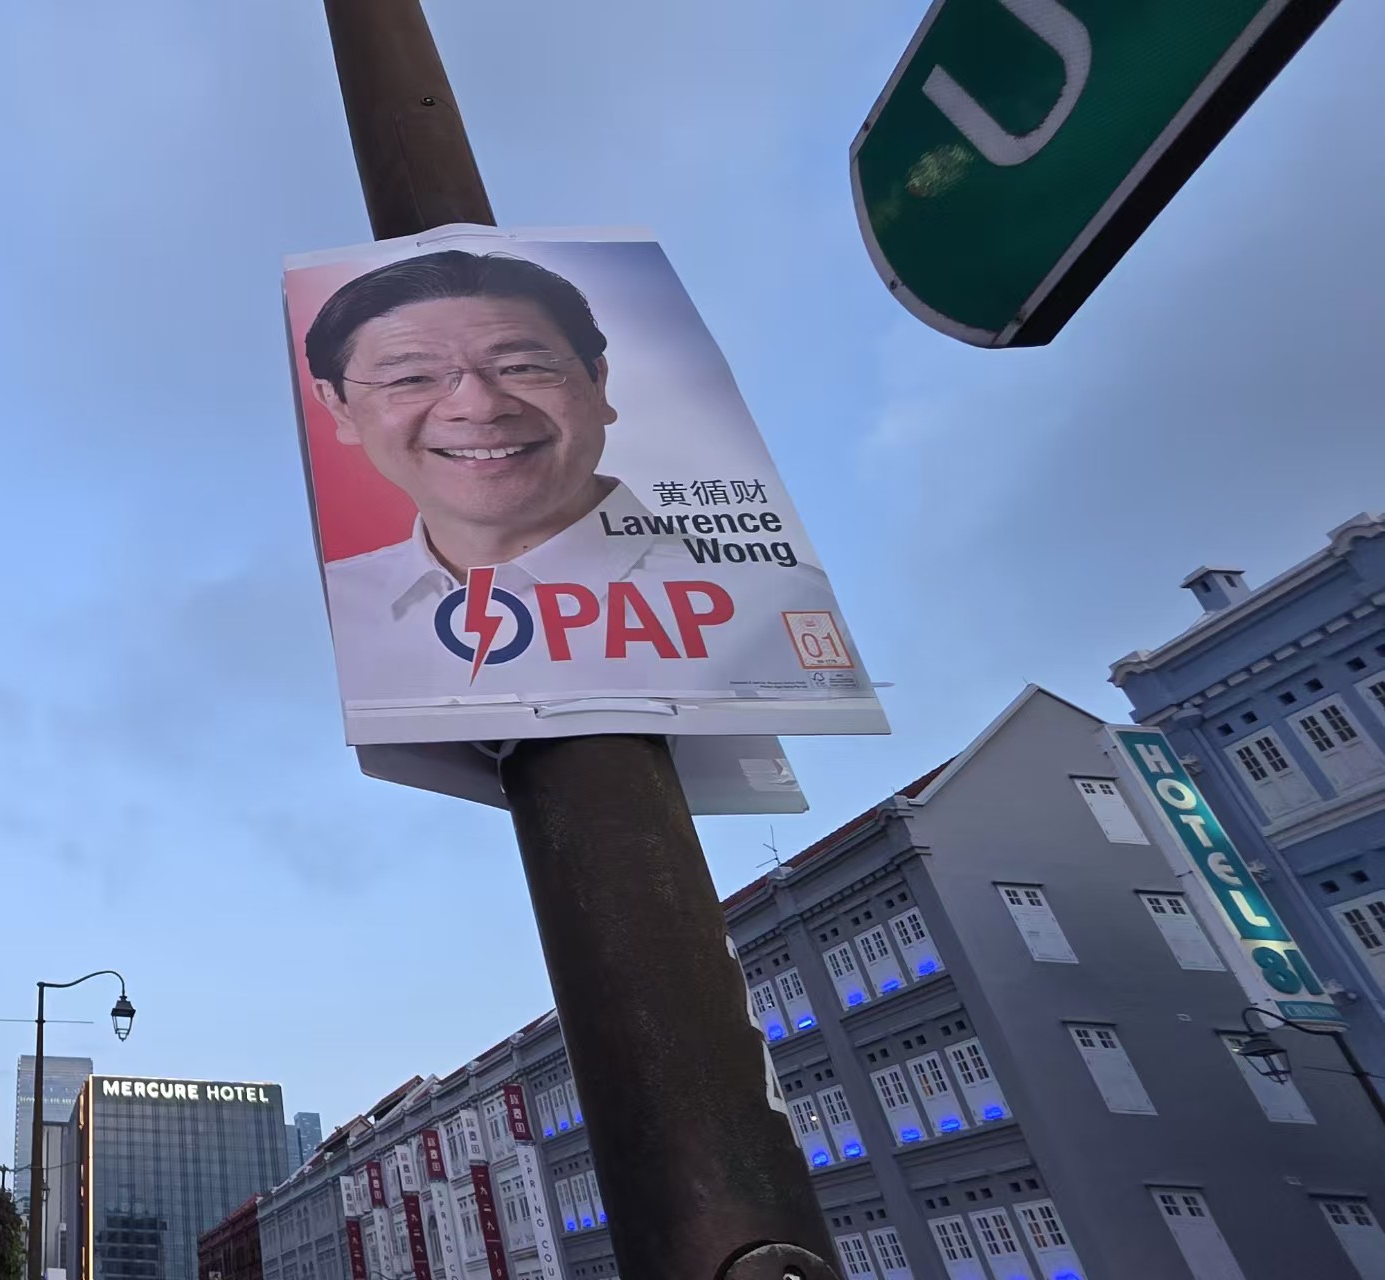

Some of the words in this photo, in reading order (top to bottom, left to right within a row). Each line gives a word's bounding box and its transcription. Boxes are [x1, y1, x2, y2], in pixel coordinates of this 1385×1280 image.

[922, 0, 1092, 166] U
[652, 479, 768, 507] 黄循财
[598, 507, 783, 537] Lawrence
[682, 537, 799, 568] Wong
[533, 580, 736, 662] PAP
[801, 632, 841, 658] 01
[1251, 946, 1326, 996] 81
[102, 1079, 198, 1100] MERCURE
[206, 1085, 269, 1103] HOTEL
[524, 1154, 545, 1228] SPRING
[437, 1190, 454, 1254] SPRING
